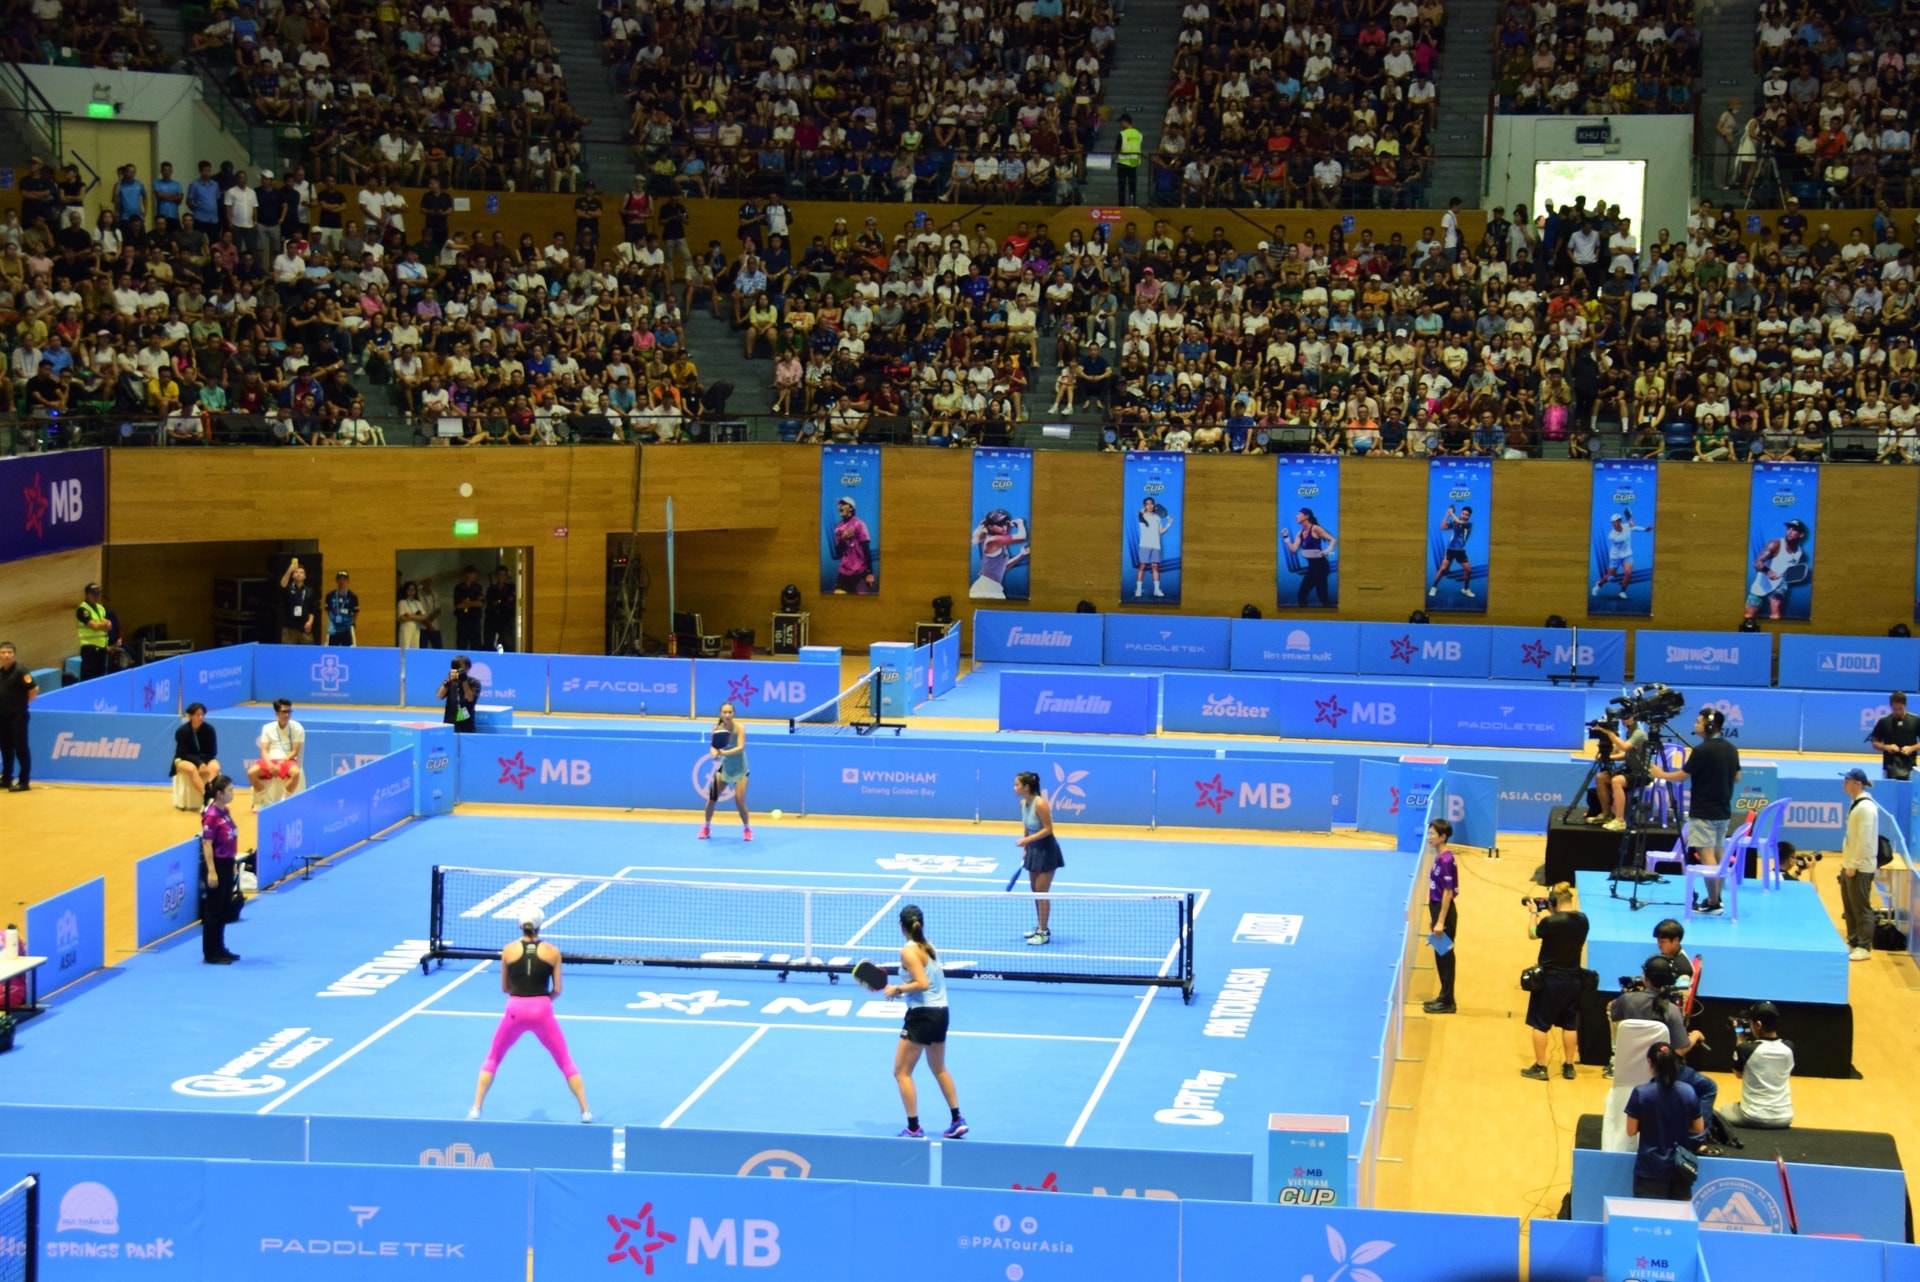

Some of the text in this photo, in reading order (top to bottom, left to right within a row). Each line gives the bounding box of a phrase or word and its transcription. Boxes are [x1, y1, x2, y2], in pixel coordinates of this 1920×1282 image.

[840, 476, 862, 485] CUP
[992, 481, 1013, 490] CUP
[1143, 484, 1165, 493] CUP
[1297, 487, 1320, 497] CUP
[1449, 490, 1471, 499] CUP
[1612, 493, 1636, 502] CUP
[1772, 495, 1796, 505] CUP
[51, 478, 83, 525] MB
[1005, 626, 1072, 647] Franklin
[1125, 642, 1206, 653] PADDLETEK
[1421, 640, 1462, 661] MB
[1554, 644, 1594, 666] MB
[1838, 654, 1878, 670] JOOLA
[155, 679, 170, 704] MB
[584, 681, 678, 694] FACOLOS
[763, 681, 806, 703] MB
[1034, 690, 1112, 714] Franklin
[1352, 702, 1397, 725] MB
[1457, 720, 1555, 732] PADDLETEK
[51, 732, 141, 760] Franklin
[425, 757, 450, 770] CUP
[540, 758, 592, 786] MB
[862, 770, 937, 784] WYNDHAM
[861, 786, 936, 798] Danang Golden Bay
[1238, 781, 1292, 810] MB
[1735, 798, 1770, 811] CUP
[1787, 805, 1839, 824] JOOLA
[286, 818, 303, 853] MB
[163, 882, 186, 913] CUP
[759, 997, 908, 1018] MB
[1306, 1168, 1323, 1177] MB
[1287, 1178, 1329, 1187] VIETNAM
[1279, 1187, 1335, 1206] CUP
[260, 1237, 465, 1258] PADDLETEK
[686, 1216, 781, 1267] MB
[957, 1235, 1074, 1254] @PPATourAsia
[1650, 1258, 1669, 1269] MB
[1629, 1269, 1676, 1281] VIETNAM
